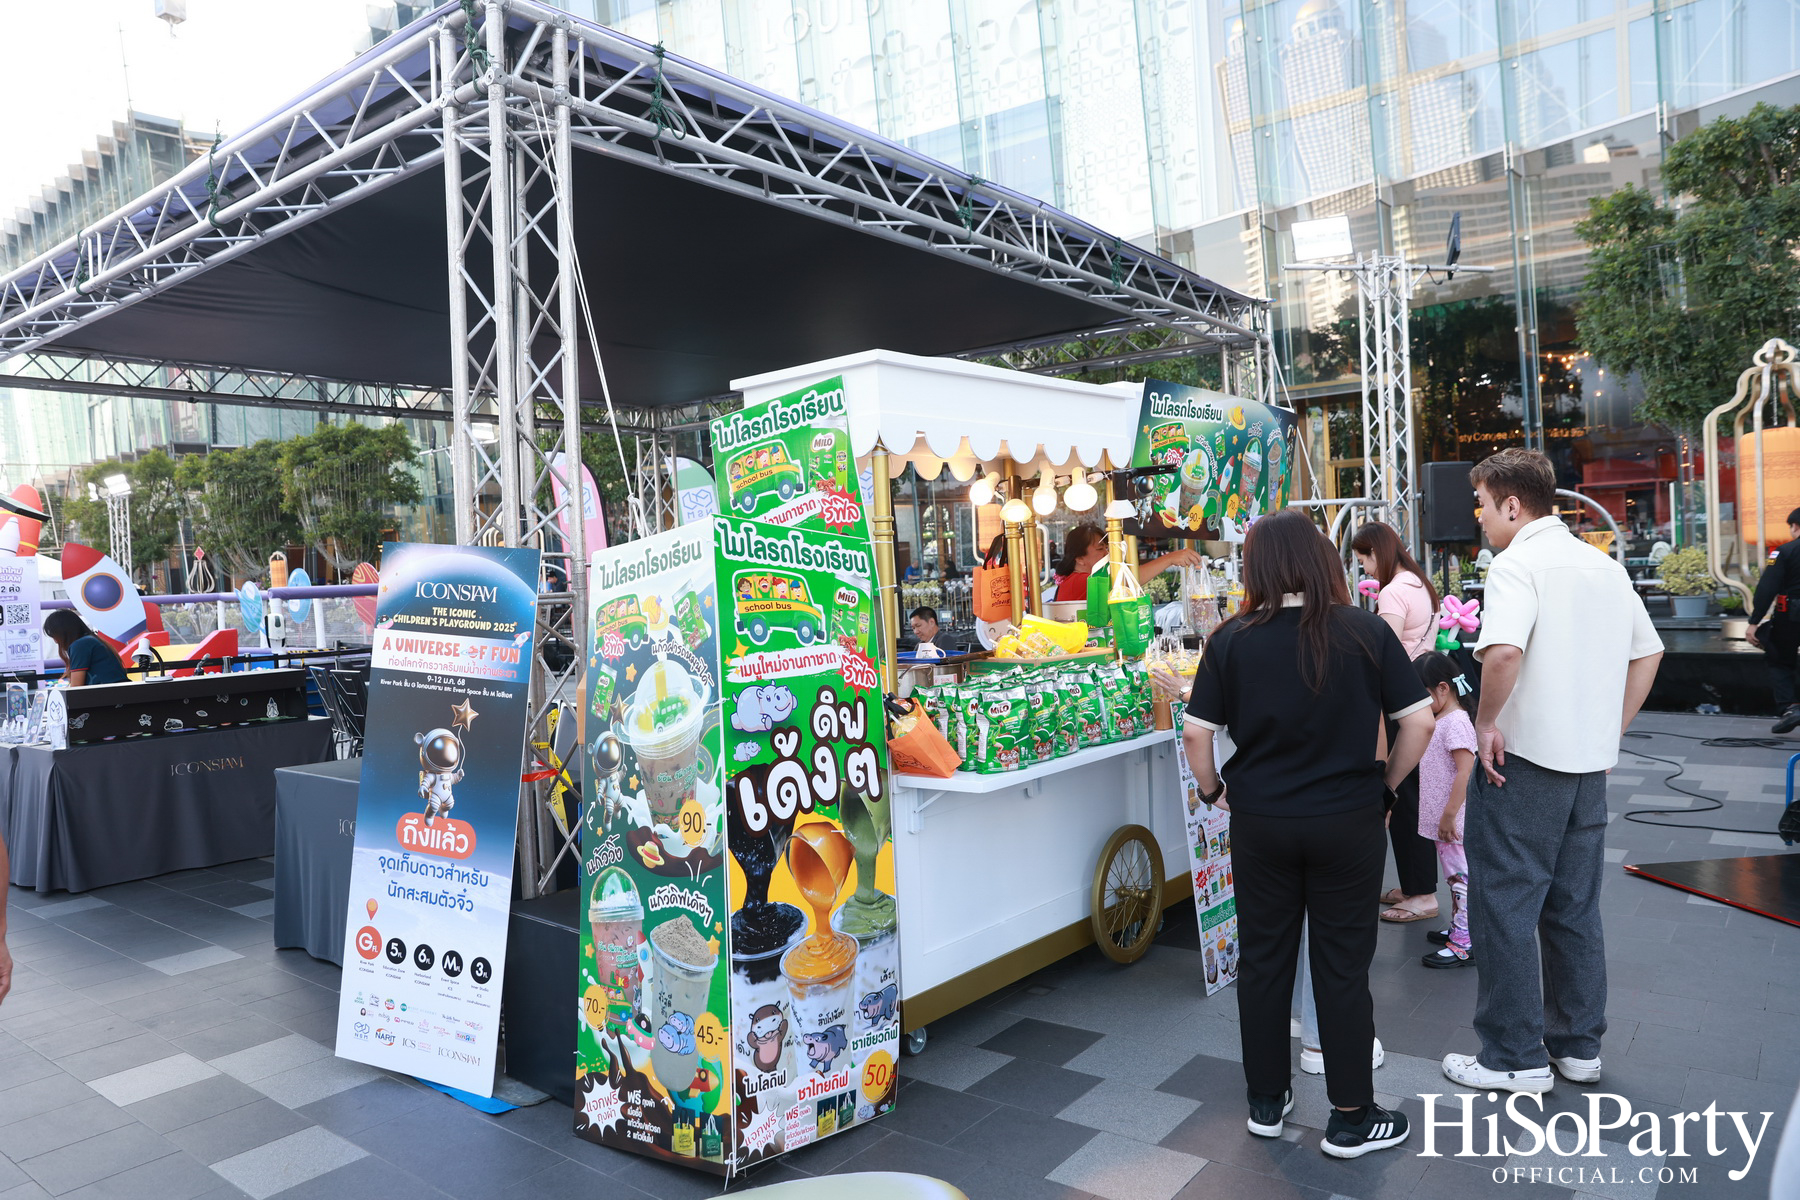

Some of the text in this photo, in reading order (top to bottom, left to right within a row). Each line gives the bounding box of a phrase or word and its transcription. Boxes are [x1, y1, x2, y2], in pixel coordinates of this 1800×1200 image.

[1151, 394, 1223, 421] ไมโลรถโรงเรียน
[716, 392, 843, 449] ไมโลรถโรงเรียน
[814, 438, 832, 447] MILO
[736, 469, 774, 490] school bus
[718, 522, 867, 574] ไมโลรถโรงเรียน
[600, 540, 702, 590] ไมโลรถโรงเรียน
[415, 582, 498, 604] ICONSIAM
[838, 592, 857, 604] MILO
[432, 607, 477, 619] THE ICONIC
[744, 601, 792, 612] school bus
[393, 614, 515, 633] CHILDREN'S PLAYGROUND 2025
[600, 619, 628, 634] school bus
[8, 643, 31, 655] 100
[382, 637, 392, 650] A
[396, 638, 460, 658] UNIVERSE
[491, 646, 521, 664] FUN
[740, 652, 837, 680] เมนูใหม่งานกาชาด
[427, 675, 442, 684] 9-12
[467, 688, 481, 696] Space
[813, 690, 864, 740] ดิฟ
[990, 705, 1009, 714] MILO
[171, 756, 244, 776] ICONSIAM
[682, 812, 712, 834] 90.-
[402, 818, 469, 854] ถึงแล้ว
[378, 853, 489, 888] จุดเก็บดาวสำหรับ
[388, 880, 474, 912] นักสะสมตัวจิ๋ว
[586, 998, 604, 1014] 70.-
[375, 1031, 396, 1043] NARIT
[402, 1038, 416, 1049] ICS
[696, 1025, 722, 1046] 45.-
[852, 1025, 898, 1051] ชาเขียวดิฟ
[438, 1047, 481, 1066] ICONSIAM
[744, 1070, 786, 1096] ไมโลดิฟ
[798, 1070, 849, 1100] ชาไทยดิฟ
[586, 1090, 618, 1113] แจกฟรี
[627, 1090, 641, 1105] ฟรี
[597, 1108, 616, 1124] ถุงผ้า
[786, 1106, 798, 1120] ฟรี
[626, 1130, 632, 1138] 2
[744, 1112, 777, 1146] แจกฟรี
